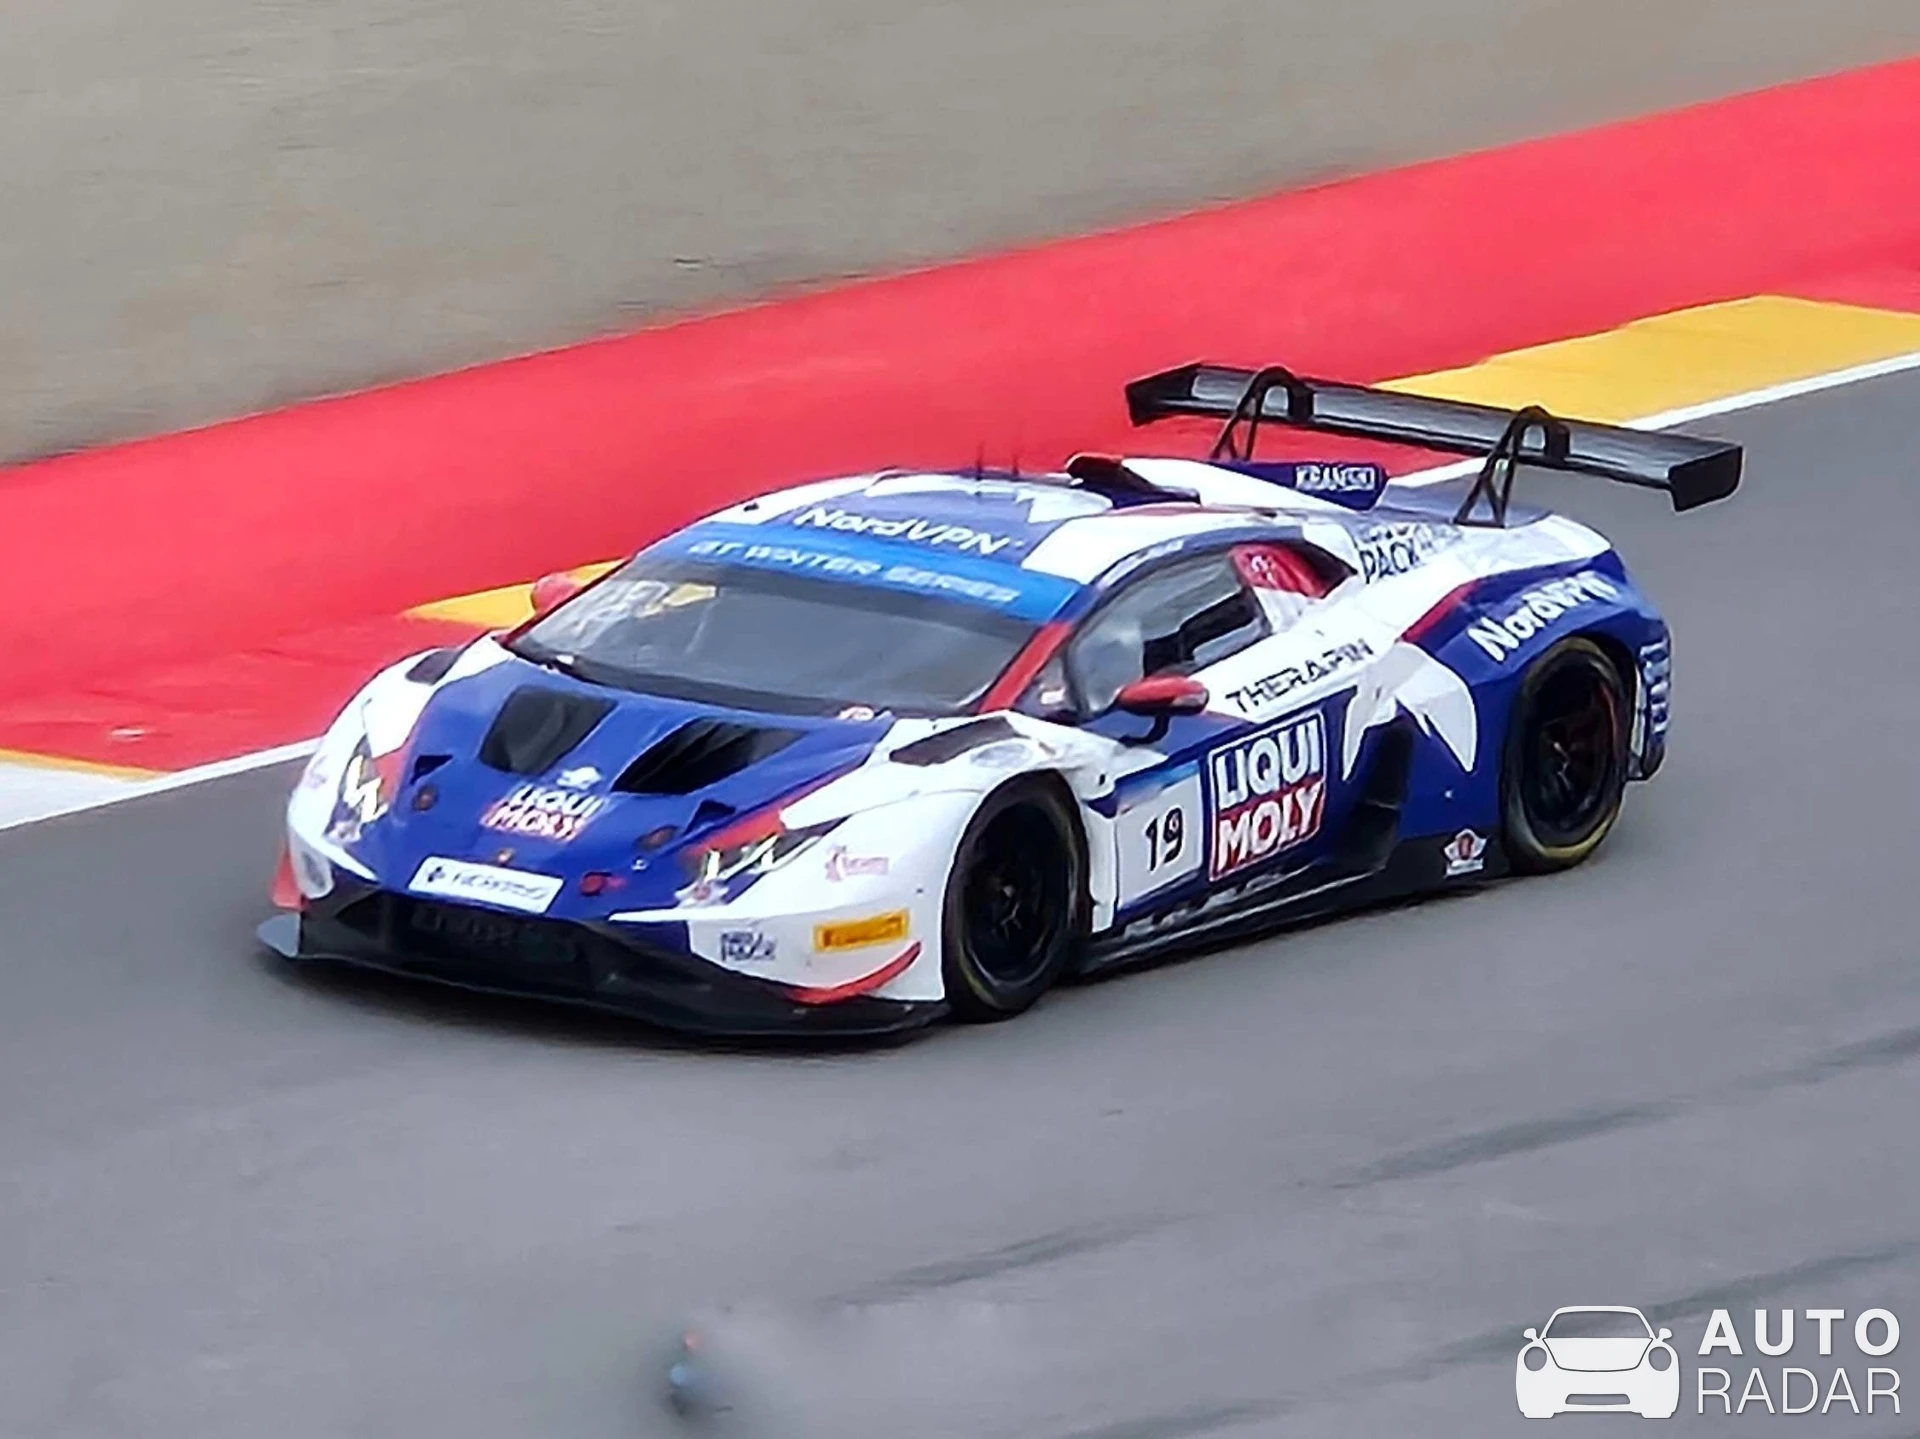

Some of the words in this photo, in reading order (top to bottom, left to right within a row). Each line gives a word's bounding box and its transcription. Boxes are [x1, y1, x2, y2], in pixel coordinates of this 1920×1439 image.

[793, 507, 1010, 555] NordVPN
[1466, 570, 1617, 661] NordVPN
[1214, 721, 1320, 812] LIQUI
[485, 801, 588, 841] MOLY
[508, 783, 605, 818] LIQUI
[1217, 782, 1322, 872] MOLY
[1146, 807, 1184, 871] 19
